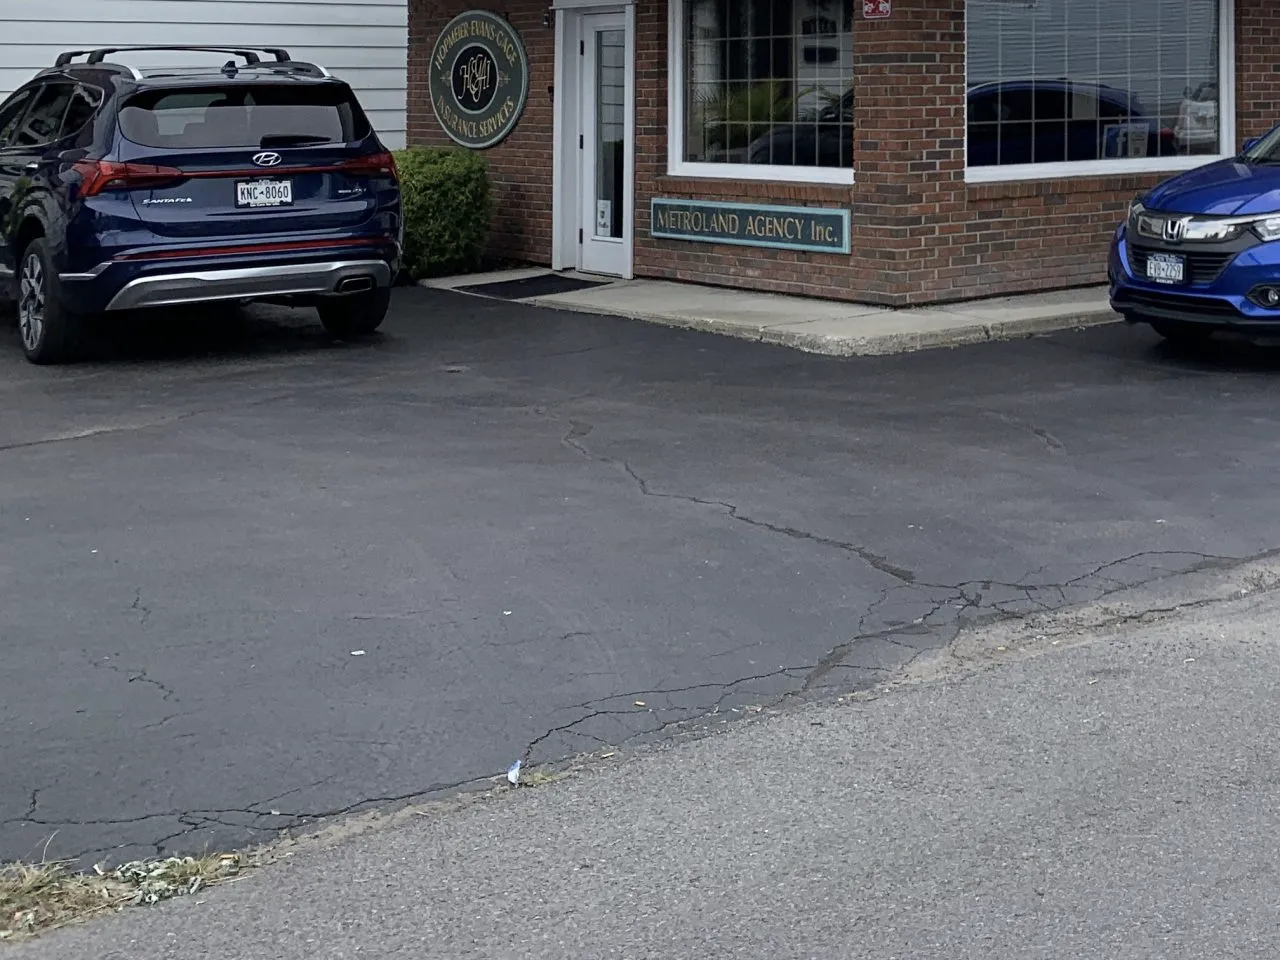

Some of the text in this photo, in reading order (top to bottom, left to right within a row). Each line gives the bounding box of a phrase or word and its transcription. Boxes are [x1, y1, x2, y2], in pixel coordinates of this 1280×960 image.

[437, 95, 514, 137] INSURANCE SERVICES
[656, 210, 838, 242] METROLAND AGENCY Inc.
